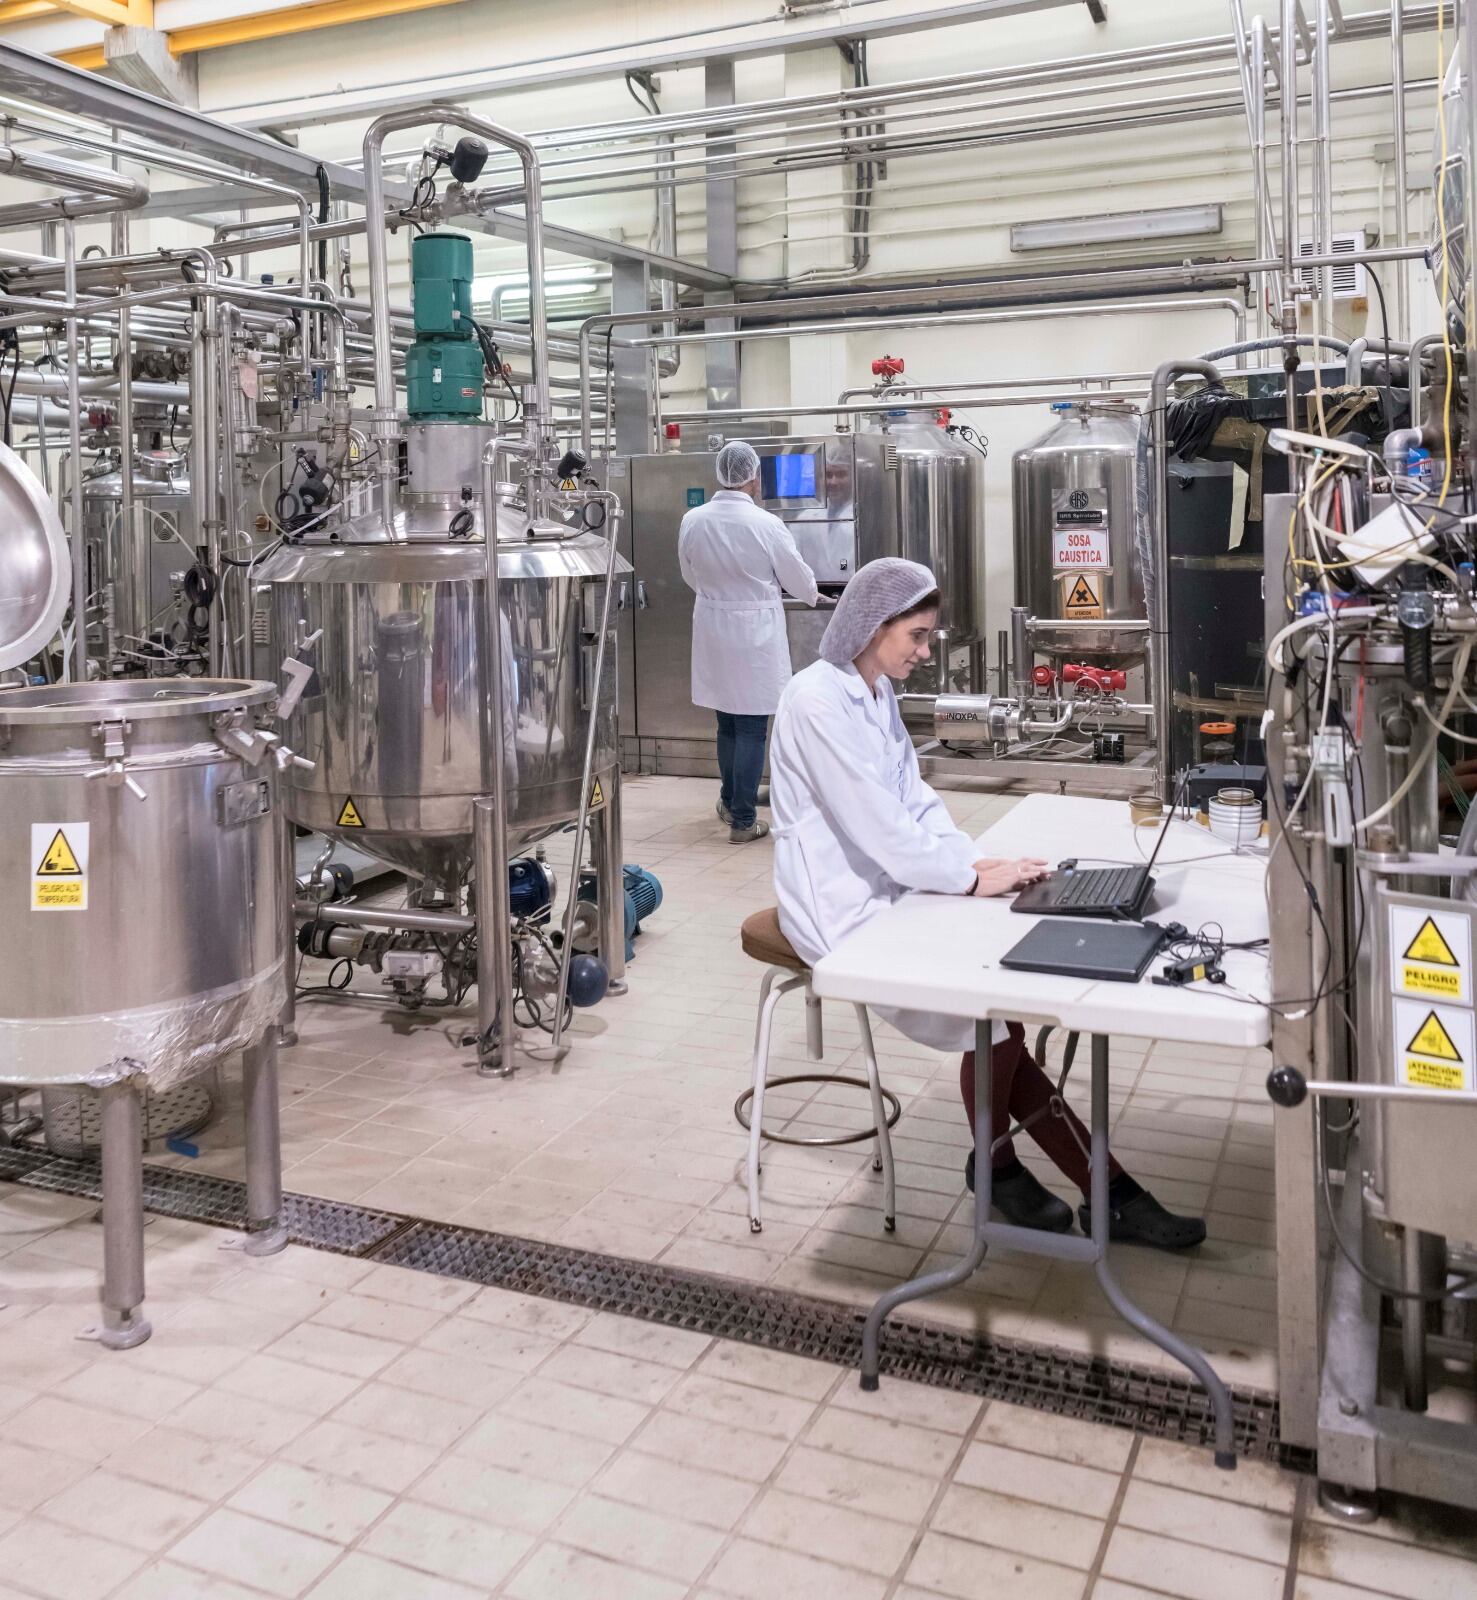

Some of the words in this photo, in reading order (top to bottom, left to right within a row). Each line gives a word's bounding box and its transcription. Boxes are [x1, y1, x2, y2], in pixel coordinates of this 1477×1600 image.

[1068, 534, 1091, 546] SOSA
[1059, 550, 1102, 563] CAUSTICA
[1405, 970, 1458, 985] PELIGRO
